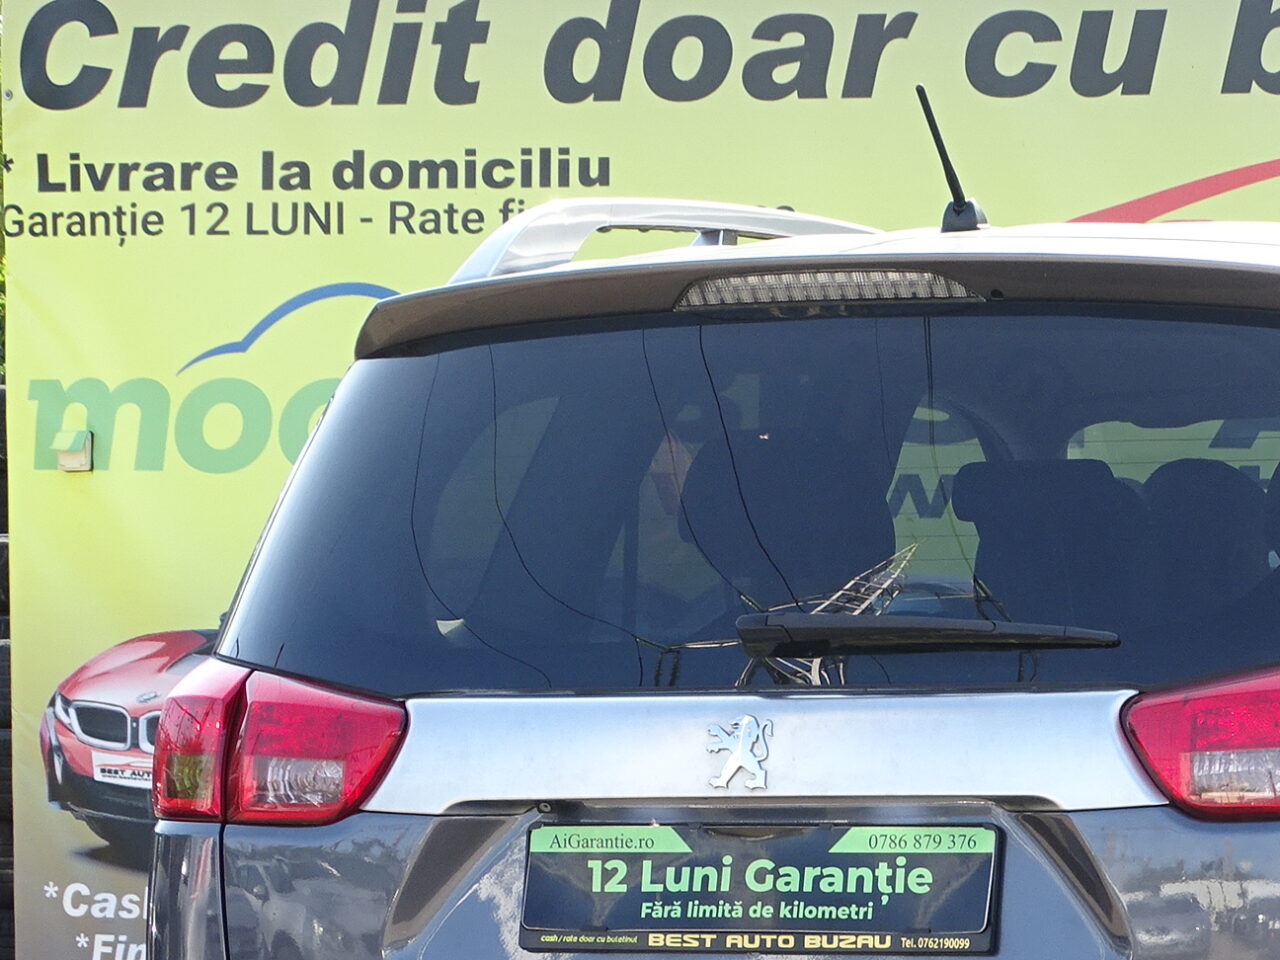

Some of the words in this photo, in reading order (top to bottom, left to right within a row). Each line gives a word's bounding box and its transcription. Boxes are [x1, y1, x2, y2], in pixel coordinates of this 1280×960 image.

[19, 0, 491, 110] Credit
[544, 0, 917, 103] doar
[965, 8, 1168, 98] cu
[37, 153, 238, 192] Livrare
[262, 151, 311, 190] la
[332, 147, 610, 190] domiciliu
[181, 203, 230, 235] 12
[246, 202, 344, 235] LUNI
[389, 200, 485, 234] Rate
[550, 834, 655, 849] AiGarantie.ro
[868, 834, 907, 850] 0786
[913, 834, 942, 850] 879
[947, 834, 977, 850] 376
[587, 859, 628, 893] 12
[640, 855, 733, 893] Luni
[745, 856, 933, 905] Garanție
[43, 881, 148, 920] Cas
[640, 901, 681, 918] Fără
[687, 901, 743, 918] limită
[749, 901, 774, 918] de
[779, 902, 874, 920] kilometri
[648, 933, 717, 947] BEST
[726, 934, 795, 948] AUTO
[804, 935, 892, 949] BUZAU
